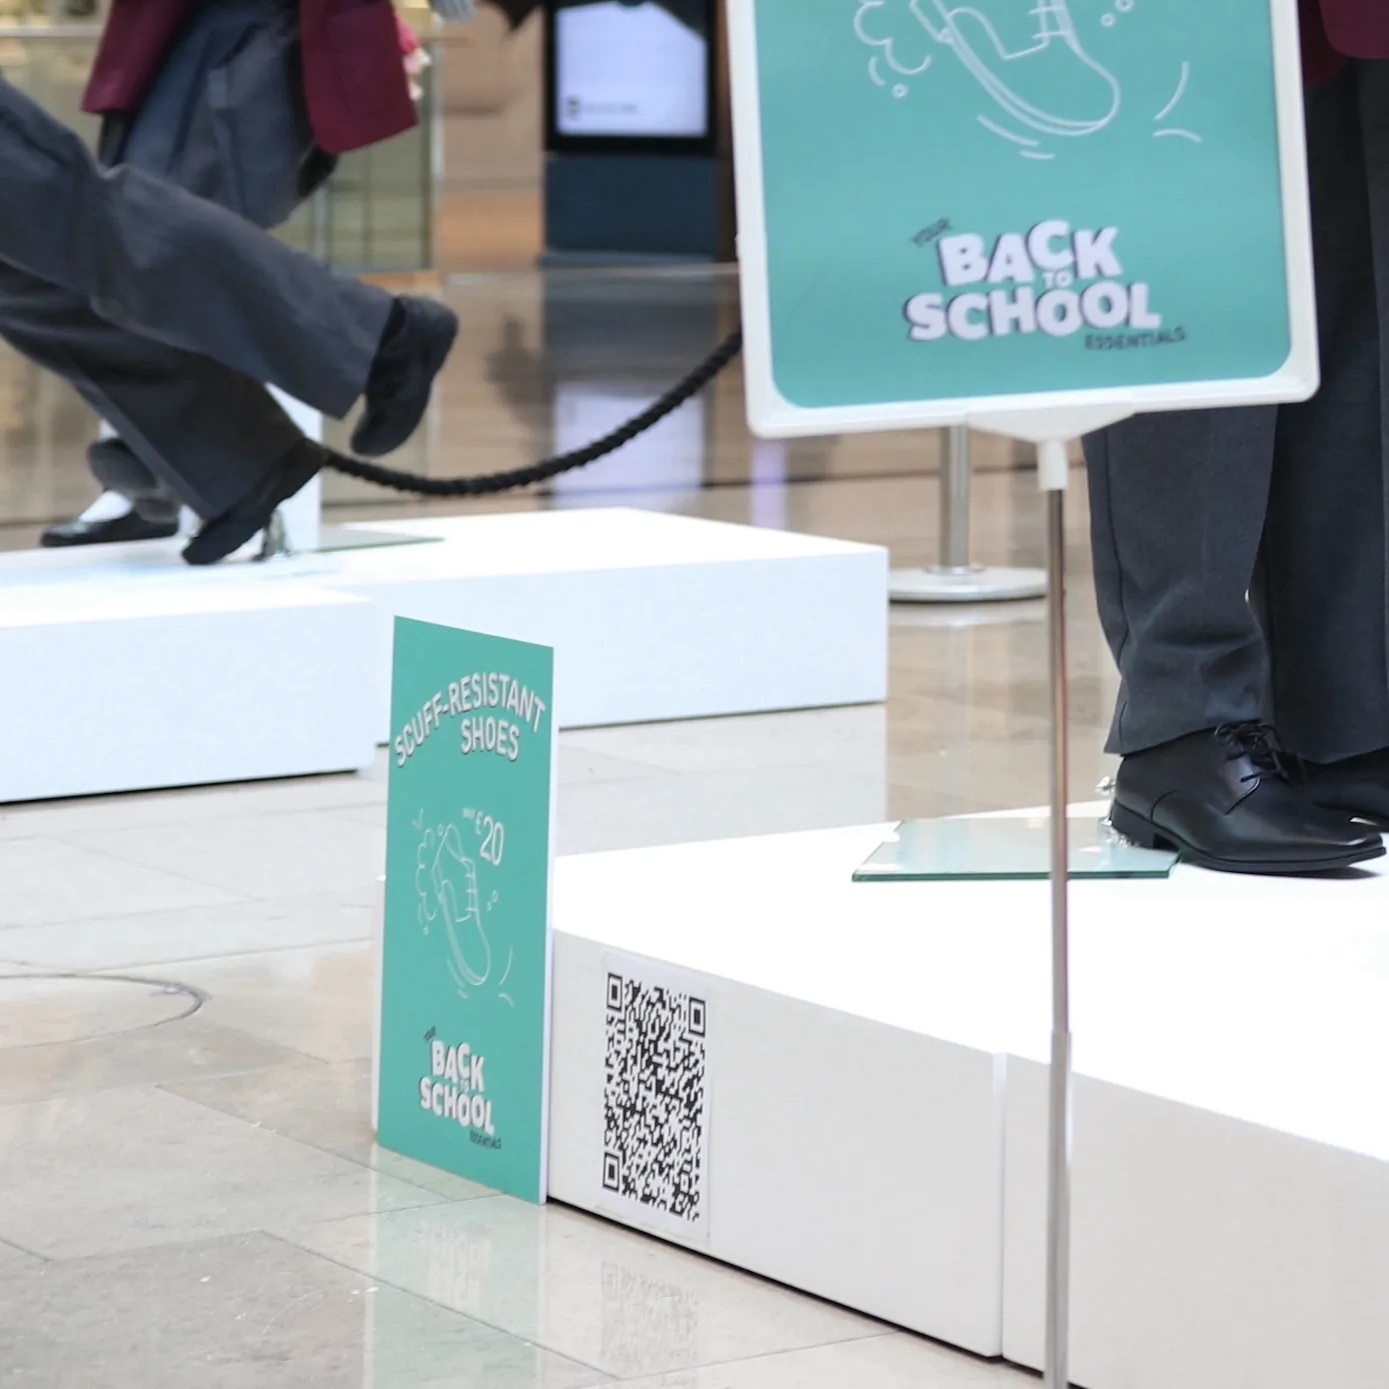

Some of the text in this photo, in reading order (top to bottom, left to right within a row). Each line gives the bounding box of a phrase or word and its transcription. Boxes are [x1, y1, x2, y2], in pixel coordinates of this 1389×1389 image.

[936, 219, 1124, 288] BACK
[1041, 271, 1074, 289] TO
[903, 281, 1163, 343] SCHOOL
[1084, 325, 1187, 351] ESSENTIALS
[394, 671, 547, 769] SCUFF-RESISTANT
[460, 716, 520, 763] SHOES
[430, 1038, 486, 1094] BACK
[419, 1075, 496, 1138] SCHOOL
